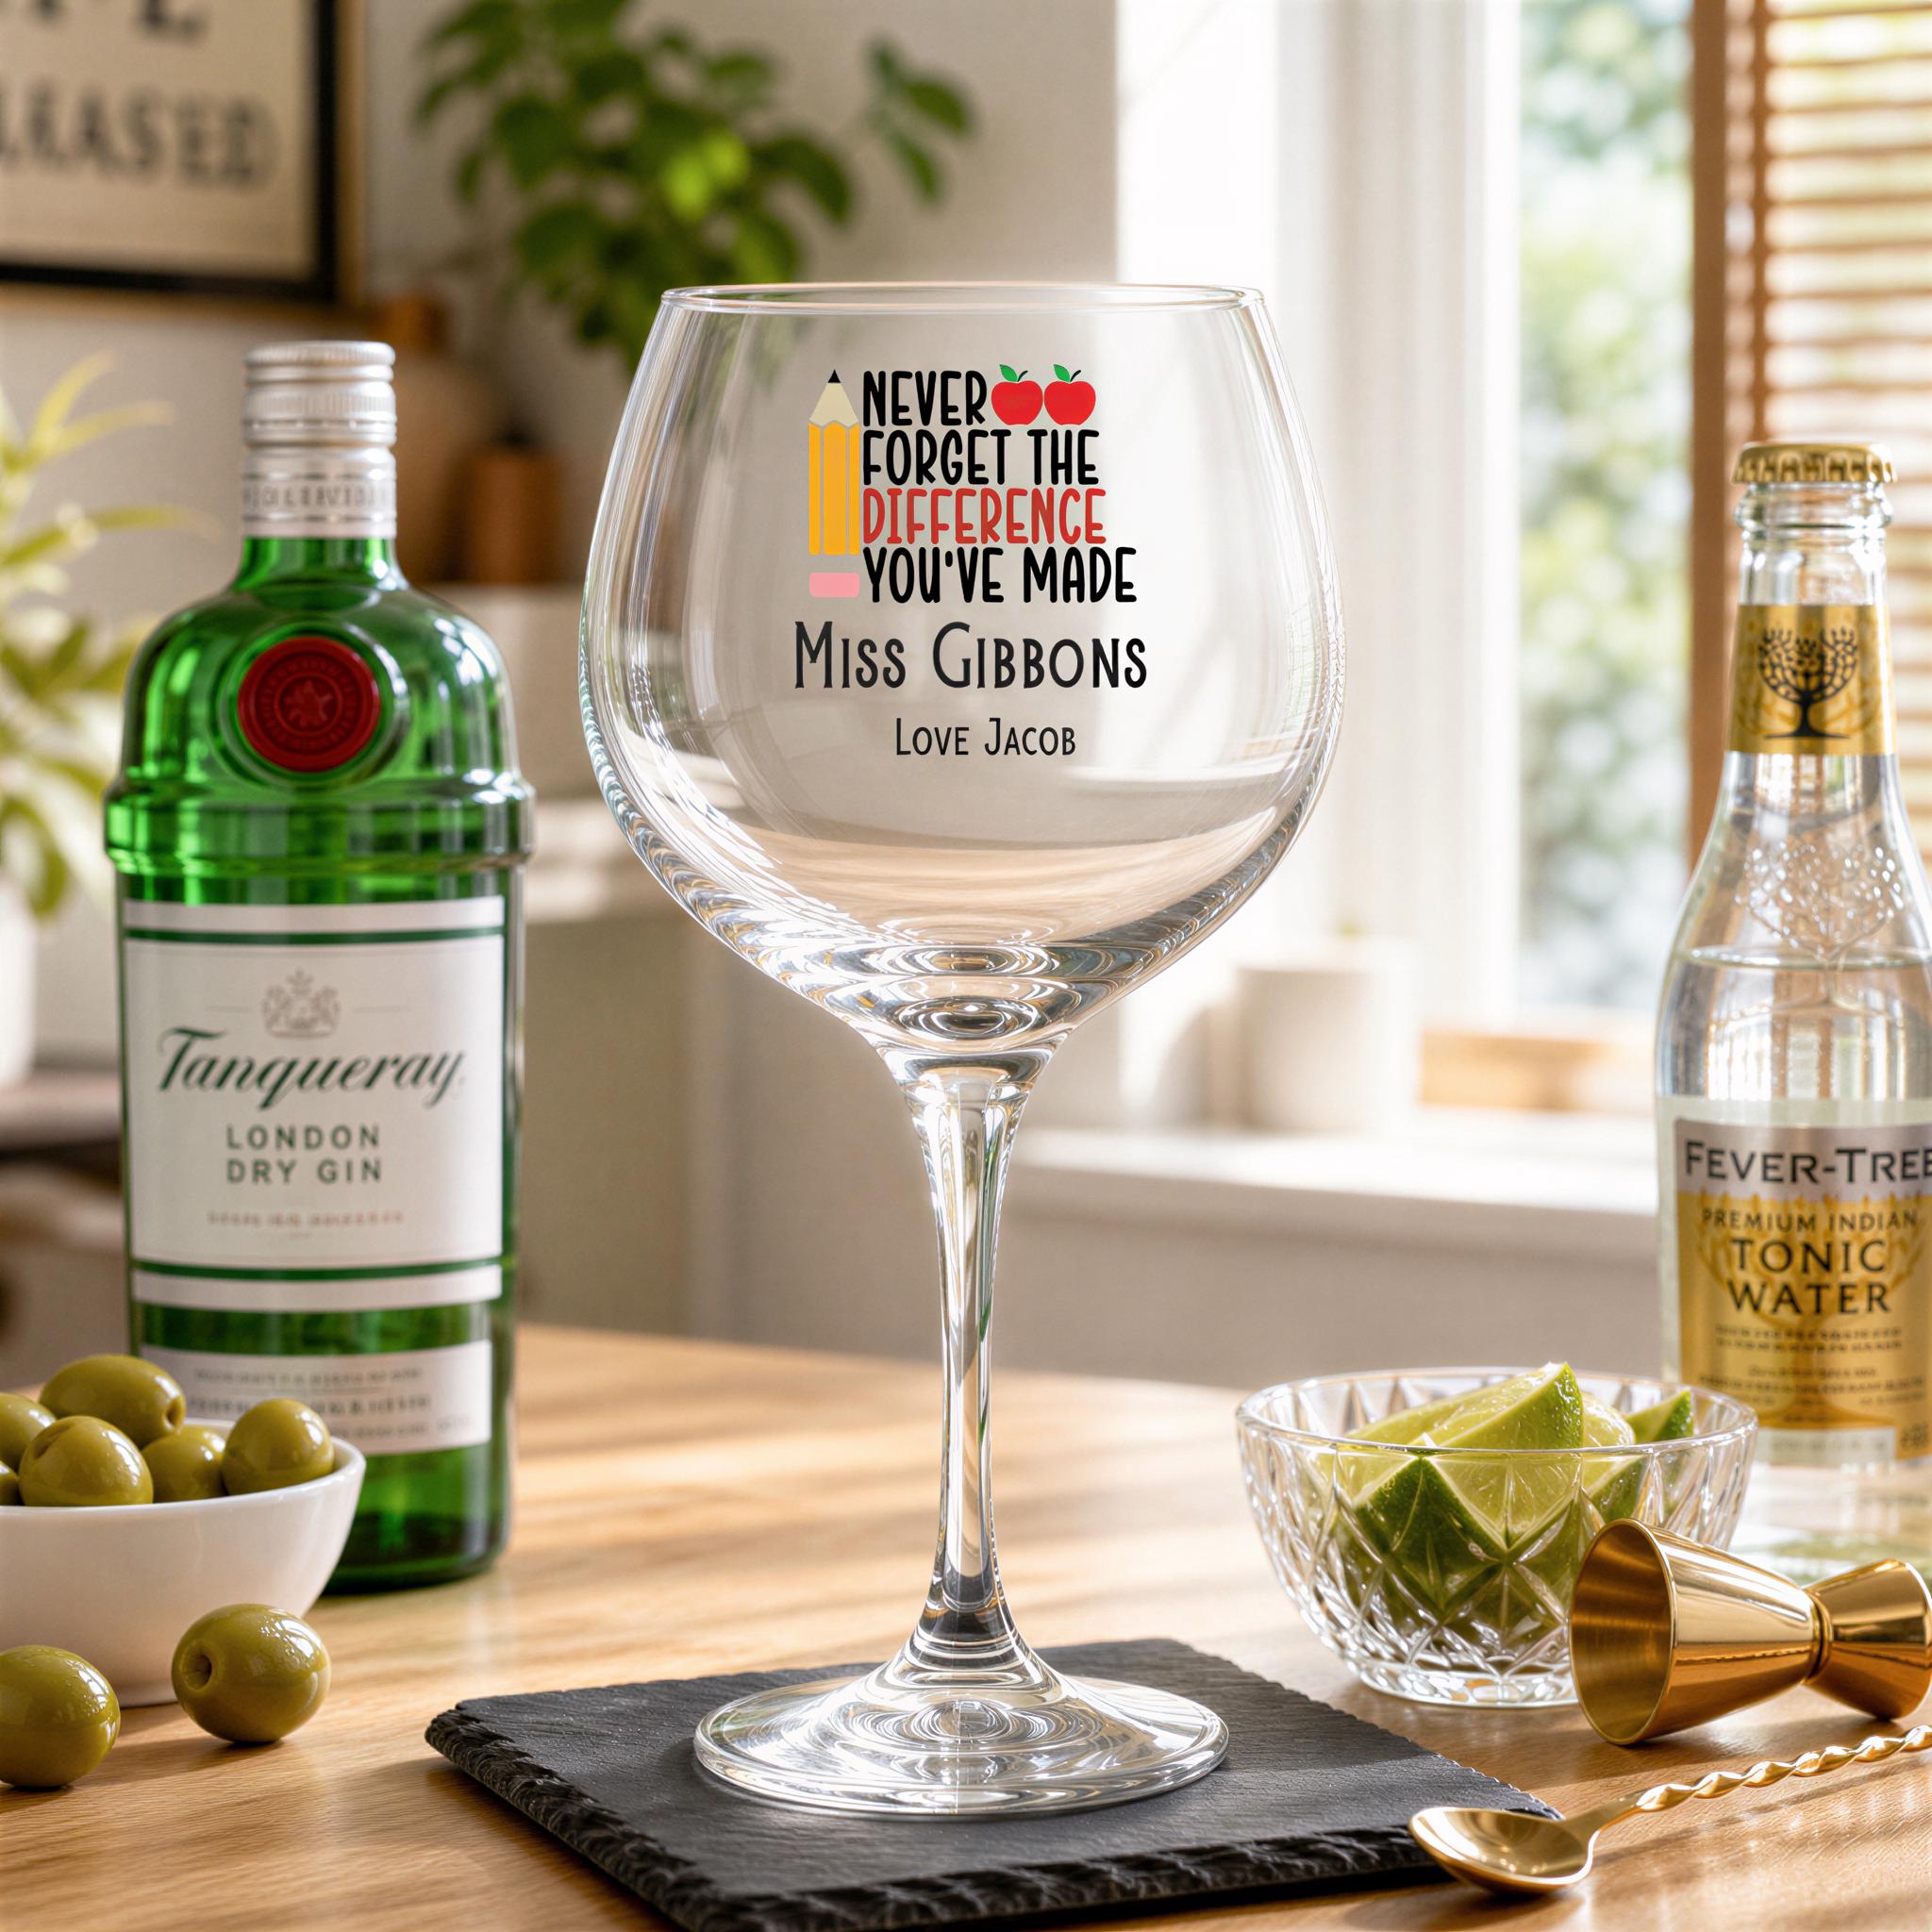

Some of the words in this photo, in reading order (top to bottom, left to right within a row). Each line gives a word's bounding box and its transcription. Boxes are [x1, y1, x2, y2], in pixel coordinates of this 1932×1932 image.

[863, 371, 987, 426] NEVER
[863, 429, 1011, 486] FORGET
[1027, 429, 1099, 485] THE
[863, 488, 1106, 544] DIFFERENCE
[863, 546, 1004, 603] YOU'VE
[1024, 547, 1137, 603] MADE
[795, 622, 906, 689] MISS
[933, 622, 1146, 689] GIBBONS
[896, 718, 969, 755] LOVE
[985, 718, 1075, 756] JACOB
[158, 1026, 465, 1111] Tanqueray
[226, 1124, 380, 1150] LONDON
[226, 1160, 297, 1184] DRY
[317, 1160, 381, 1183] GIN
[1702, 1208, 1817, 1232] PREMIUM
[1828, 1208, 1919, 1232] INDIAN
[1730, 1238, 1887, 1274] TONIC
[1727, 1281, 1891, 1314] WATER
